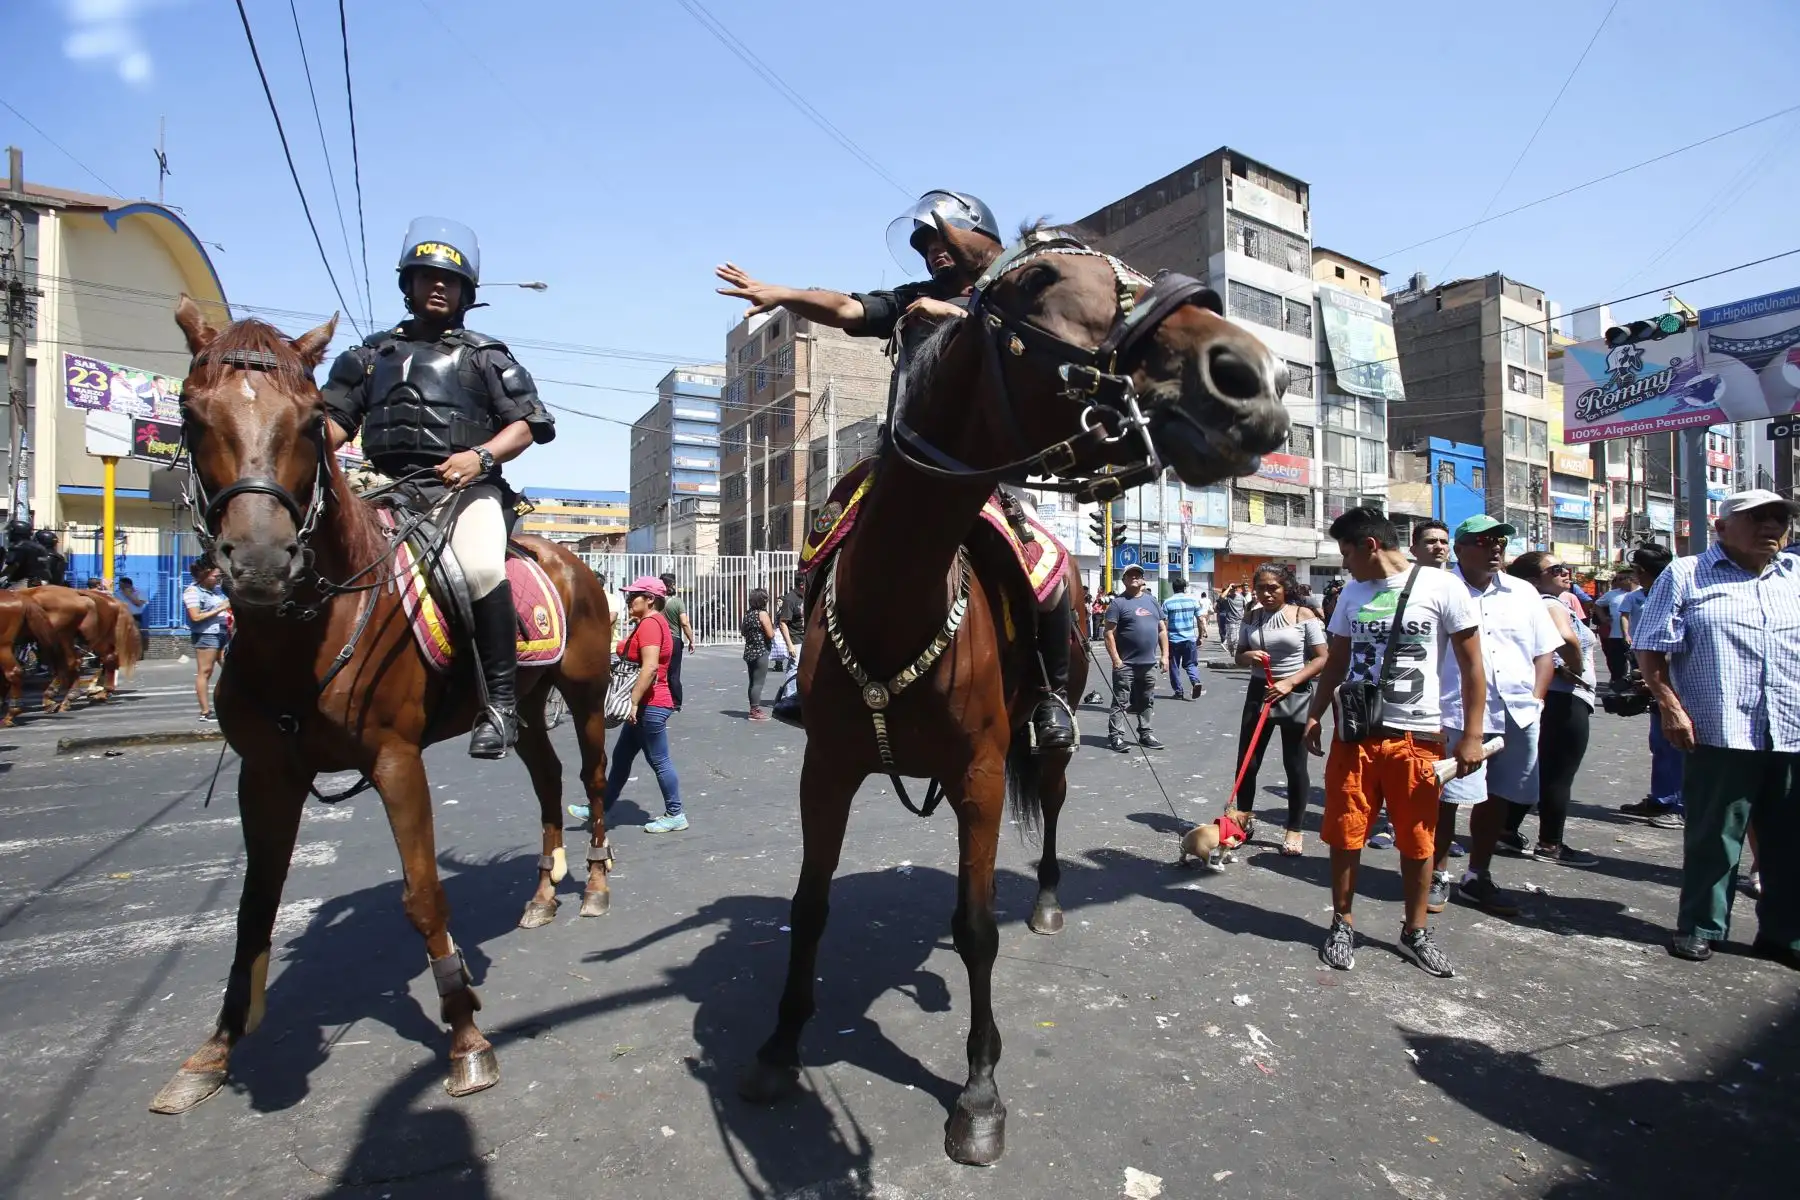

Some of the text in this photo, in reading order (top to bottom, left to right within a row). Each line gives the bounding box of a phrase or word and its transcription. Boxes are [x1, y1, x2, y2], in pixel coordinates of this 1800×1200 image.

[69, 366, 108, 391] 23
[1576, 367, 1676, 417] Rommy
[1619, 396, 1643, 409] como
[1572, 413, 1711, 440] 100% Algodón Peruano
